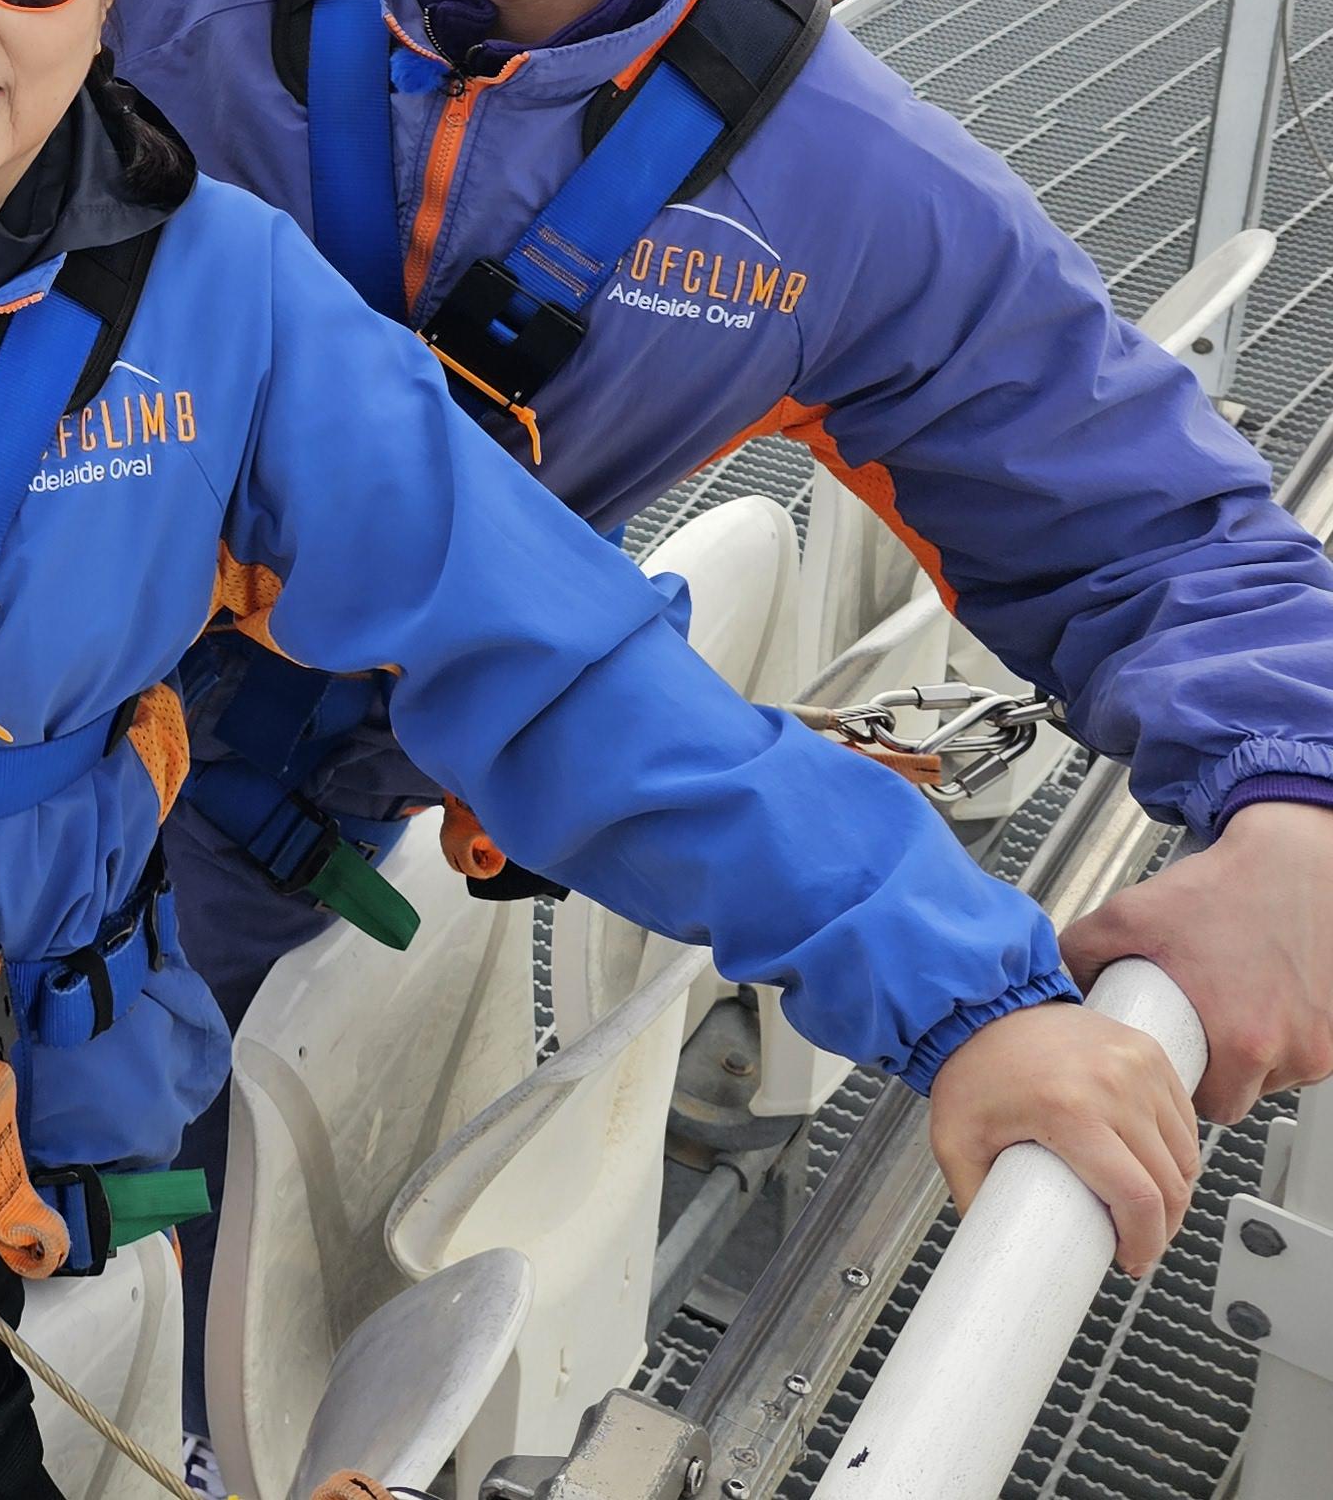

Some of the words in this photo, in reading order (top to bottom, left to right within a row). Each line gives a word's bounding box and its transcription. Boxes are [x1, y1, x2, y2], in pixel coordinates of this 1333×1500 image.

[615, 238, 808, 315] OFCLIMB
[607, 282, 702, 319] Adelaide
[706, 304, 756, 330] Oval
[42, 391, 197, 460] FCLIMB
[28, 460, 105, 493] delaide
[109, 453, 153, 480] Oval
